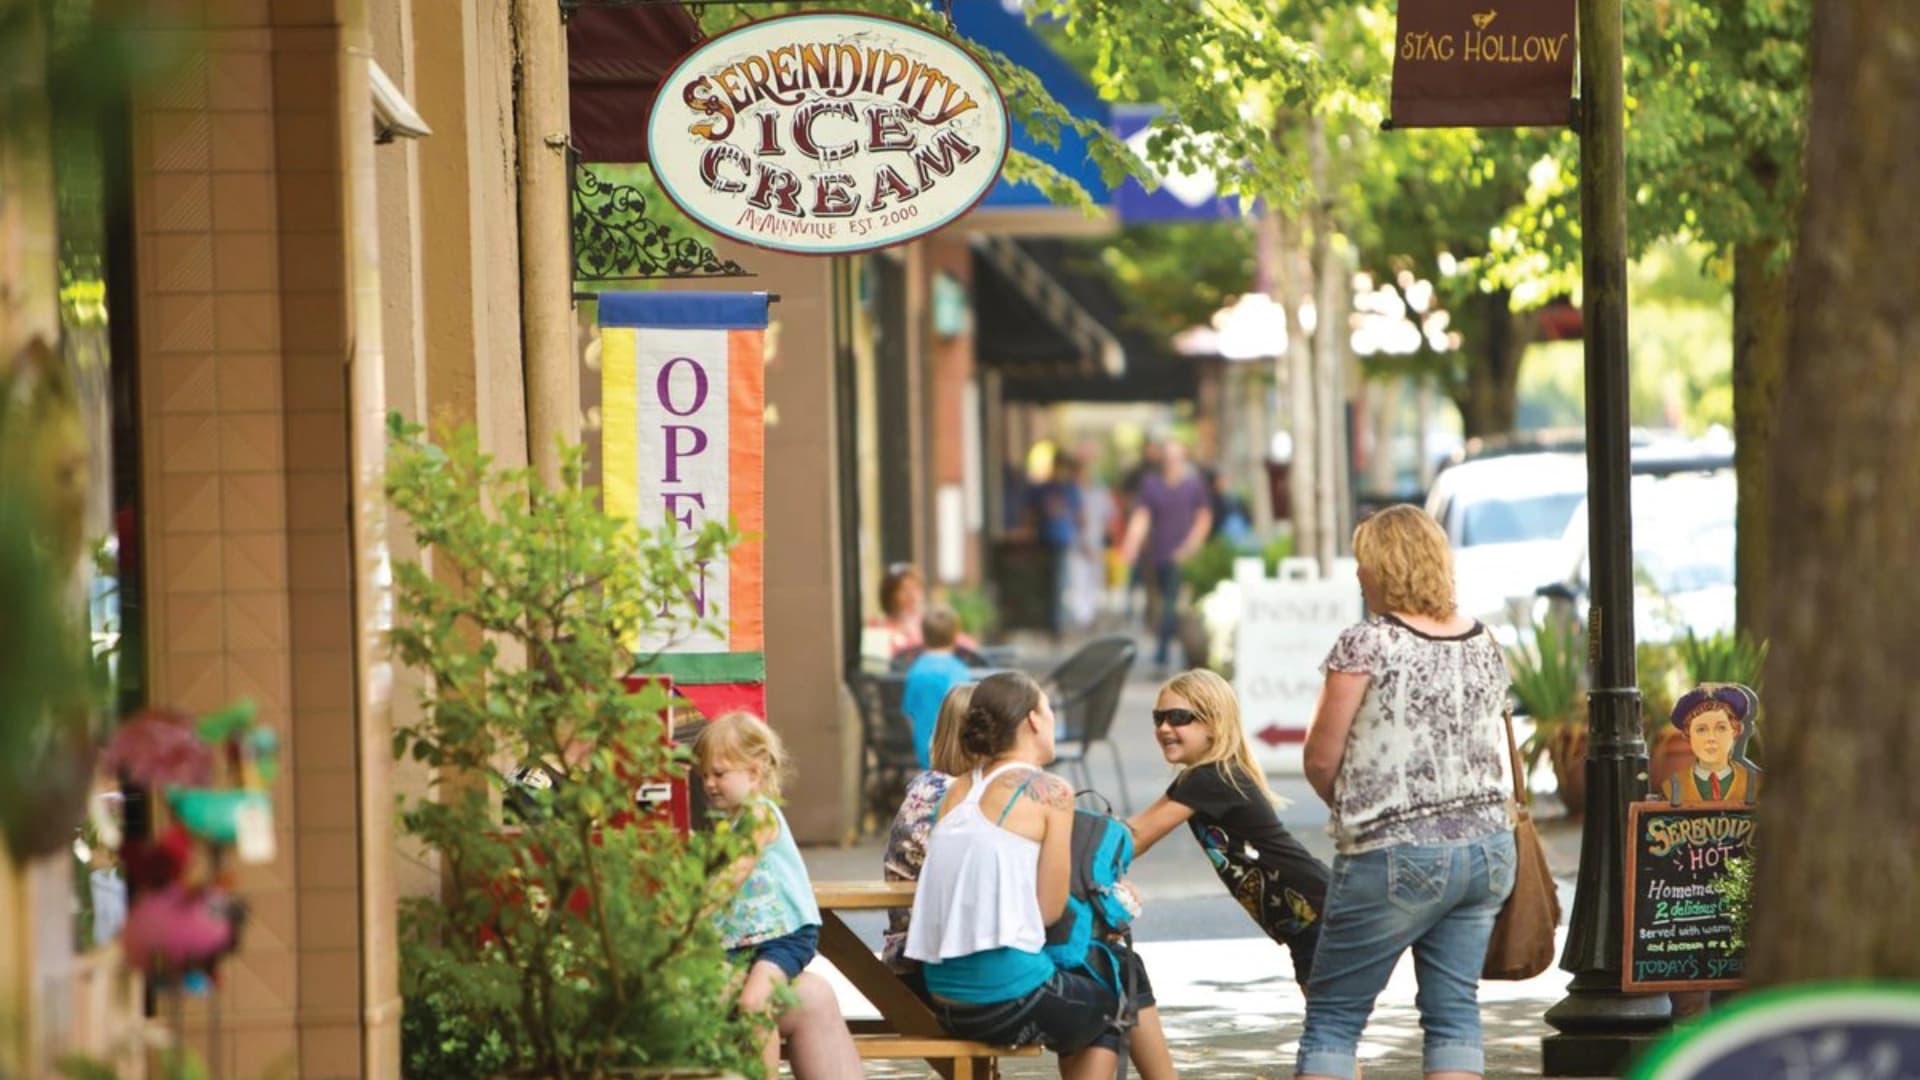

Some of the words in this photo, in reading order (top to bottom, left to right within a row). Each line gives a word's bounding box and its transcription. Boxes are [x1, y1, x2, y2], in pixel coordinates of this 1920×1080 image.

[1401, 32, 1455, 61] STAG
[1463, 31, 1569, 62] HOLLOW
[682, 43, 978, 141] SERENDIPITY
[754, 101, 917, 161] ICE
[700, 128, 980, 218] CREAM
[850, 217, 874, 236] EST
[880, 204, 918, 228] 2000
[656, 357, 709, 619] OPEN
[1689, 845, 1734, 871] HOT
[1655, 901, 1669, 919] 2
[1636, 954, 1700, 980] TODAY'S
